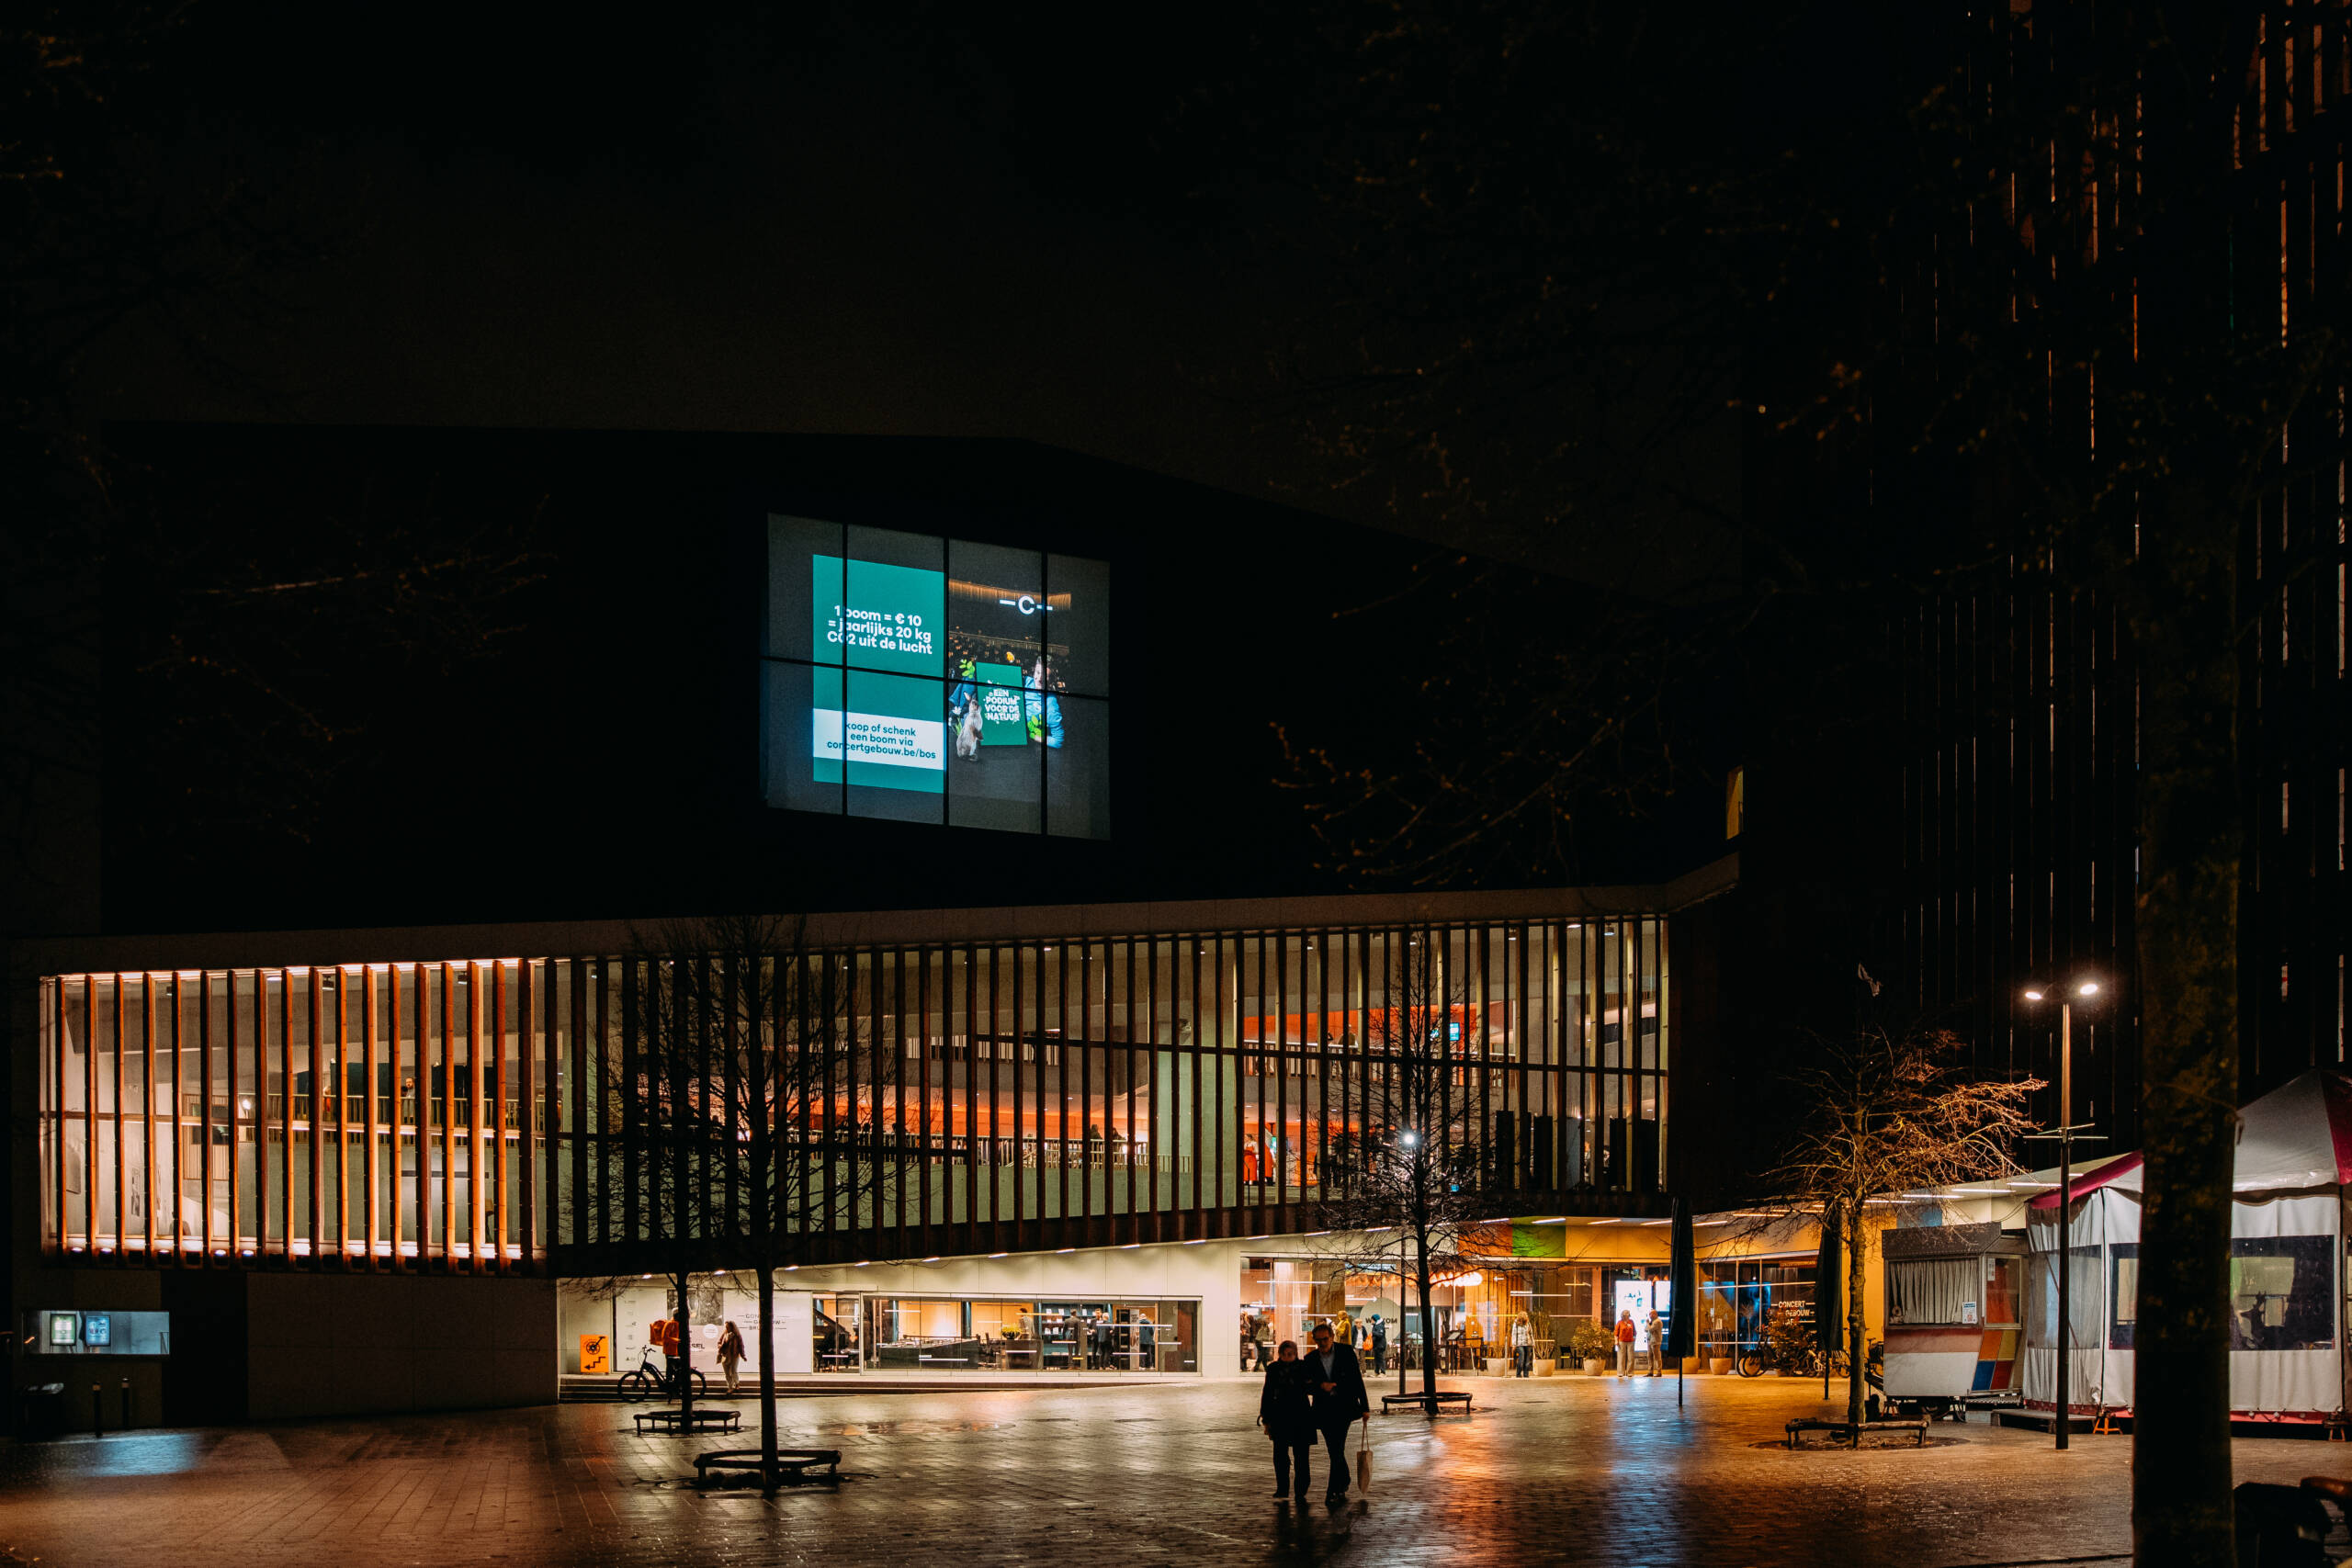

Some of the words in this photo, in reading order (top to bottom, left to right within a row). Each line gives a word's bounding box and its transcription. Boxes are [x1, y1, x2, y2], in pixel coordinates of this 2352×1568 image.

[834, 605, 841, 616] 1
[895, 613, 905, 625] €
[907, 615, 922, 626] 10
[896, 626, 912, 638] 20
[915, 628, 932, 643] kg
[859, 635, 877, 648] uit
[879, 637, 896, 649] de
[899, 639, 933, 654] lucht
[985, 705, 1008, 714] VOOR
[871, 724, 880, 732] of
[882, 726, 917, 736] schenk
[850, 733, 867, 741] een
[870, 734, 897, 745] boom
[899, 737, 913, 747] via
[1778, 1301, 1805, 1309] CONCERT
